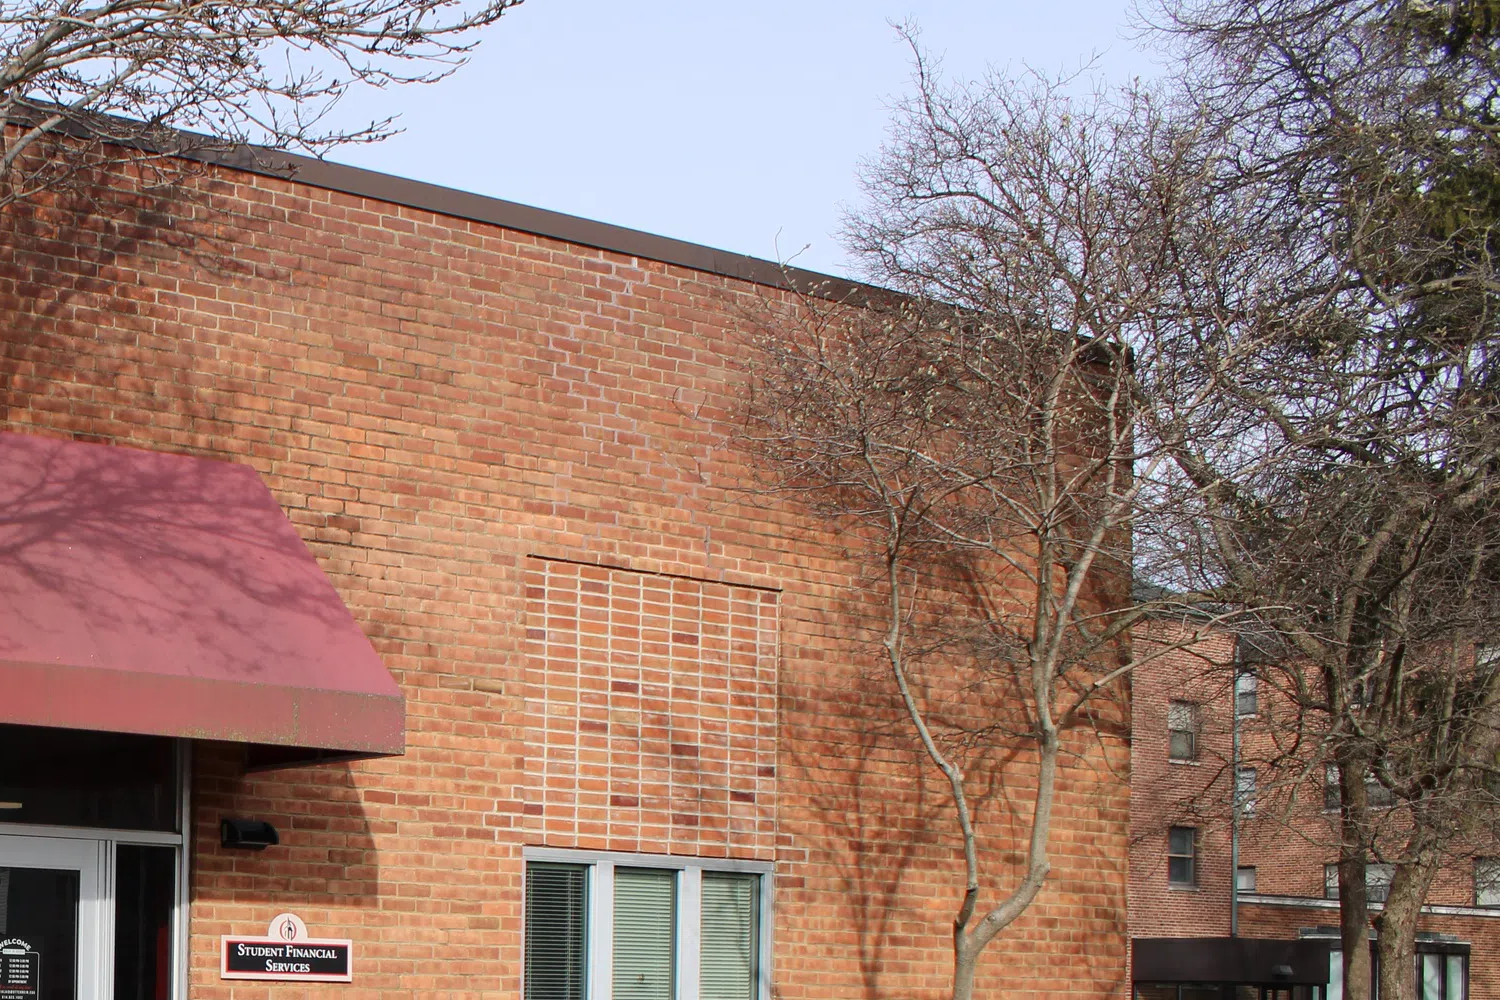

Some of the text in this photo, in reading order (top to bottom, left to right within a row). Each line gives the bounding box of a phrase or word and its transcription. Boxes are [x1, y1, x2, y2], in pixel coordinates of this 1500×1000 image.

[237, 943, 338, 959] STUDENT FINANCIAL
[265, 959, 311, 973] SERVICES
